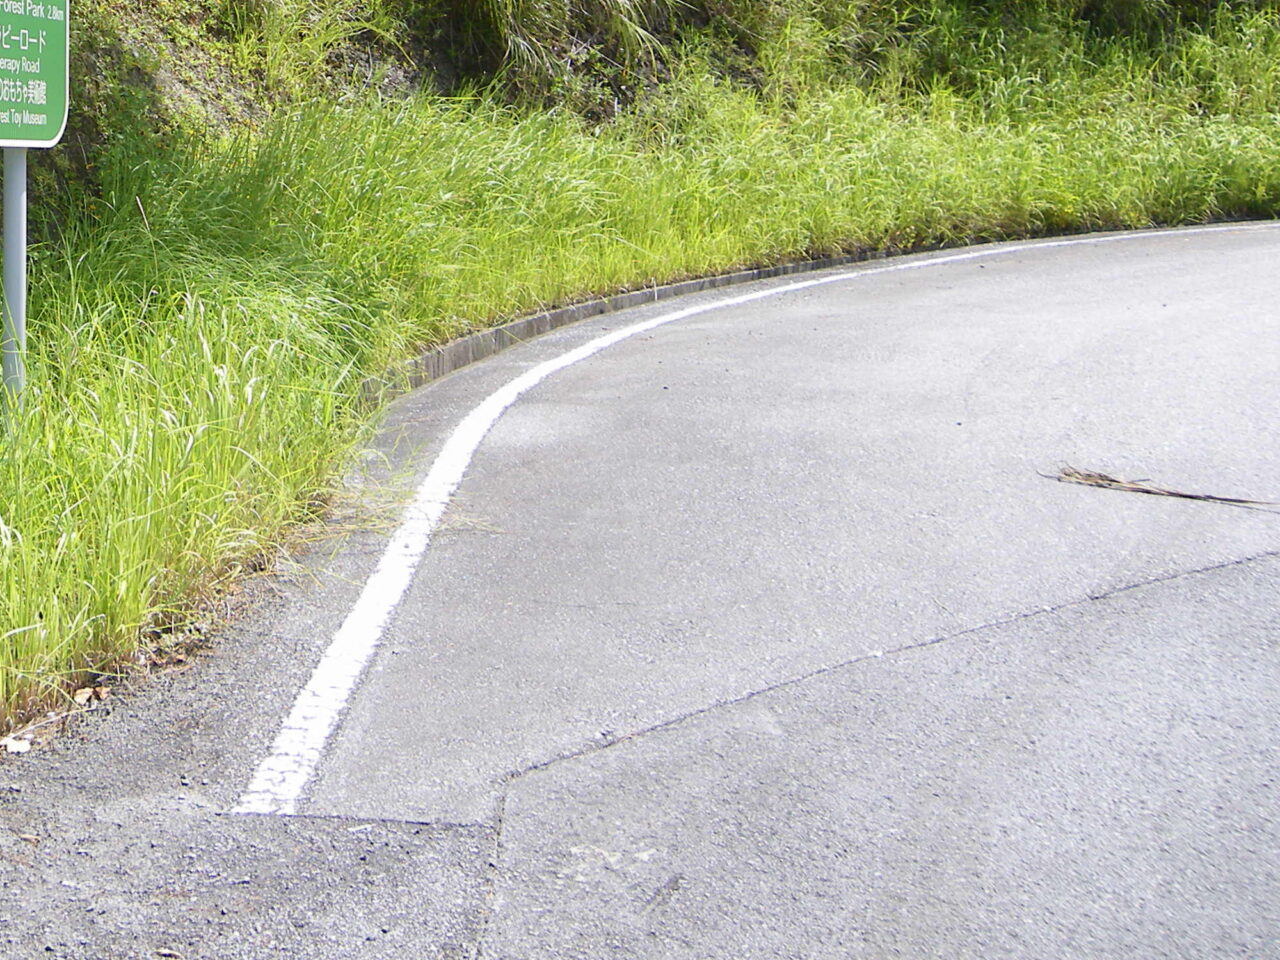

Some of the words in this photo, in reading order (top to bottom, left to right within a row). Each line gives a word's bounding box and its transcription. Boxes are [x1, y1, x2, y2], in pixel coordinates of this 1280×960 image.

[27, 0, 45, 18] Park
[22, 56, 40, 73] Road
[10, 108, 21, 127] Toy
[22, 110, 47, 125] Museum
